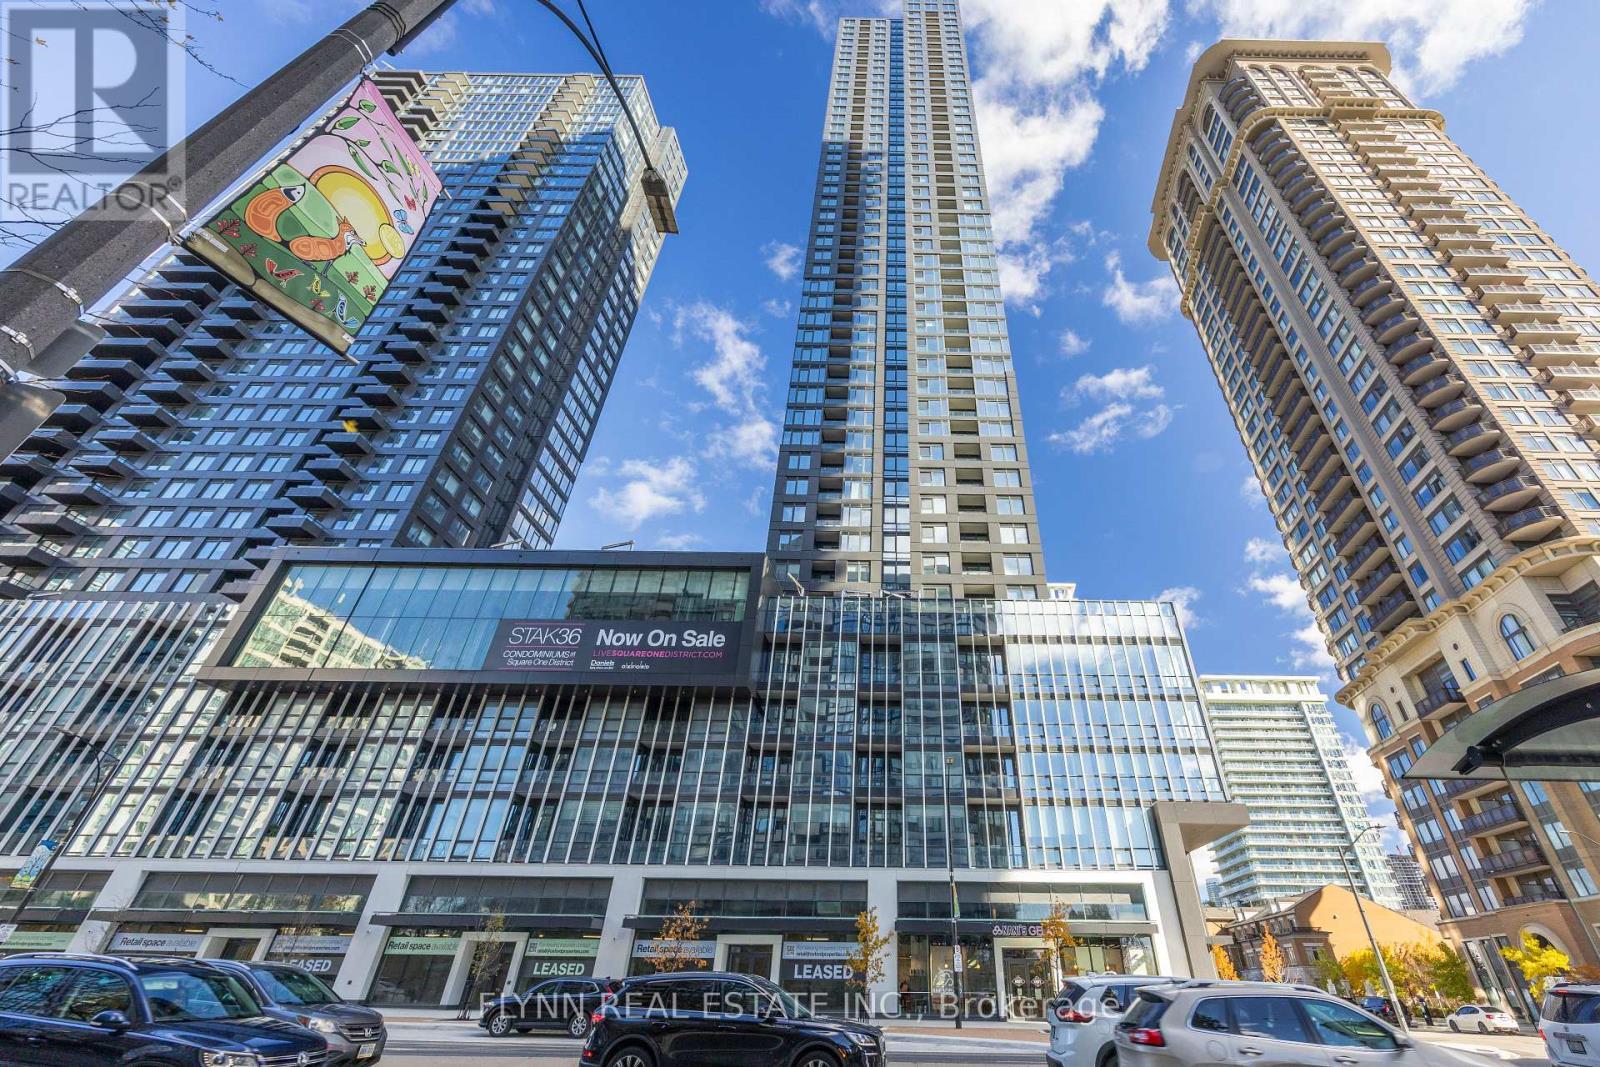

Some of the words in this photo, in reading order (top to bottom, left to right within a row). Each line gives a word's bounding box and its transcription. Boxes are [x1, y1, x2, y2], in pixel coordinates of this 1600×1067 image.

[508, 627, 583, 645] STAK36
[596, 628, 643, 646] Now
[647, 629, 677, 647] On
[682, 629, 726, 647] Sale
[503, 650, 570, 659] CONDOMINIUMS
[593, 650, 723, 658] LIVESQUAREONEDISTRICT.COM
[506, 658, 533, 667] Square
[533, 658, 548, 666] One
[120, 937, 143, 947] Retail
[143, 939, 166, 948] space
[387, 941, 409, 951] Retail
[409, 942, 432, 952] space
[636, 944, 659, 953] Retail
[533, 963, 585, 976] LEASED
[794, 964, 854, 980] LEASED
